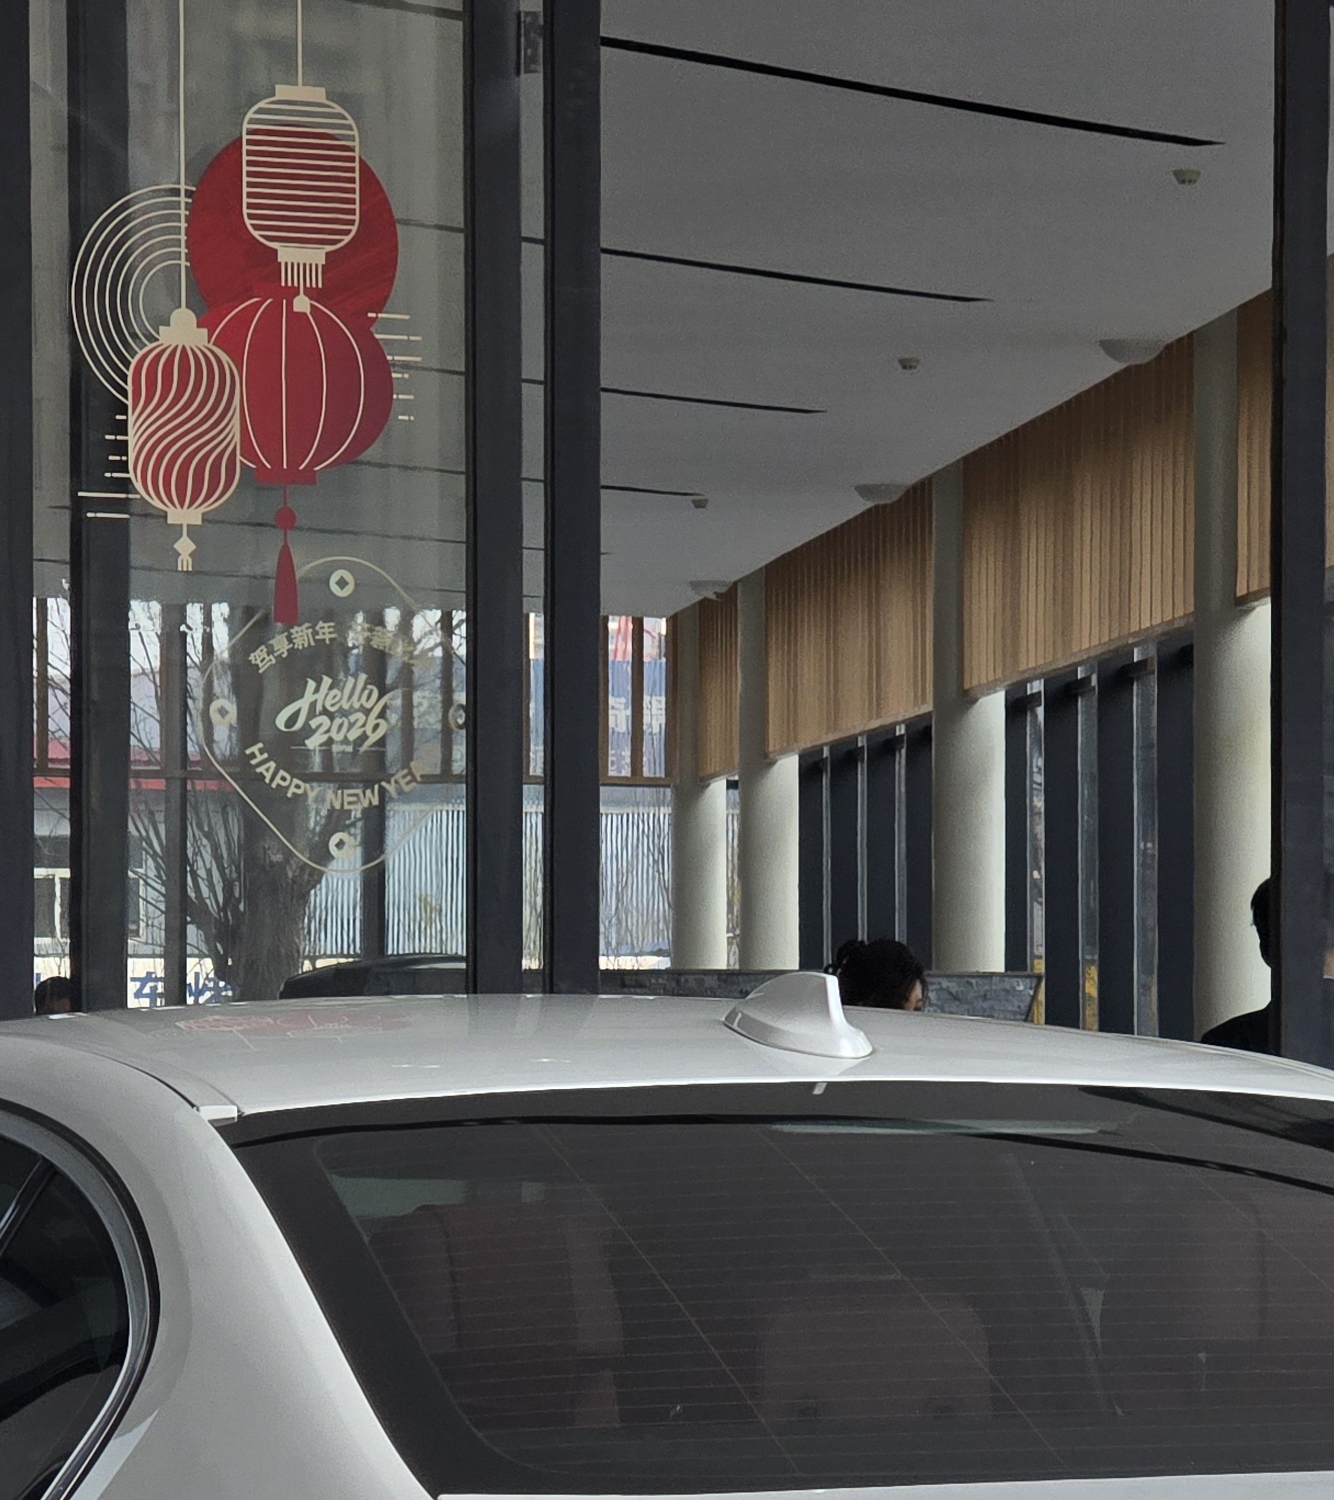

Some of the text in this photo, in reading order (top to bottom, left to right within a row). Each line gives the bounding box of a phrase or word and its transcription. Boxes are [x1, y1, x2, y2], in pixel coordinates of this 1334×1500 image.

[245, 620, 338, 674] 驾享新年
[275, 672, 379, 732] Hello
[304, 687, 407, 754] 2026
[244, 742, 321, 799] HAPPY
[326, 783, 380, 811] NEW
